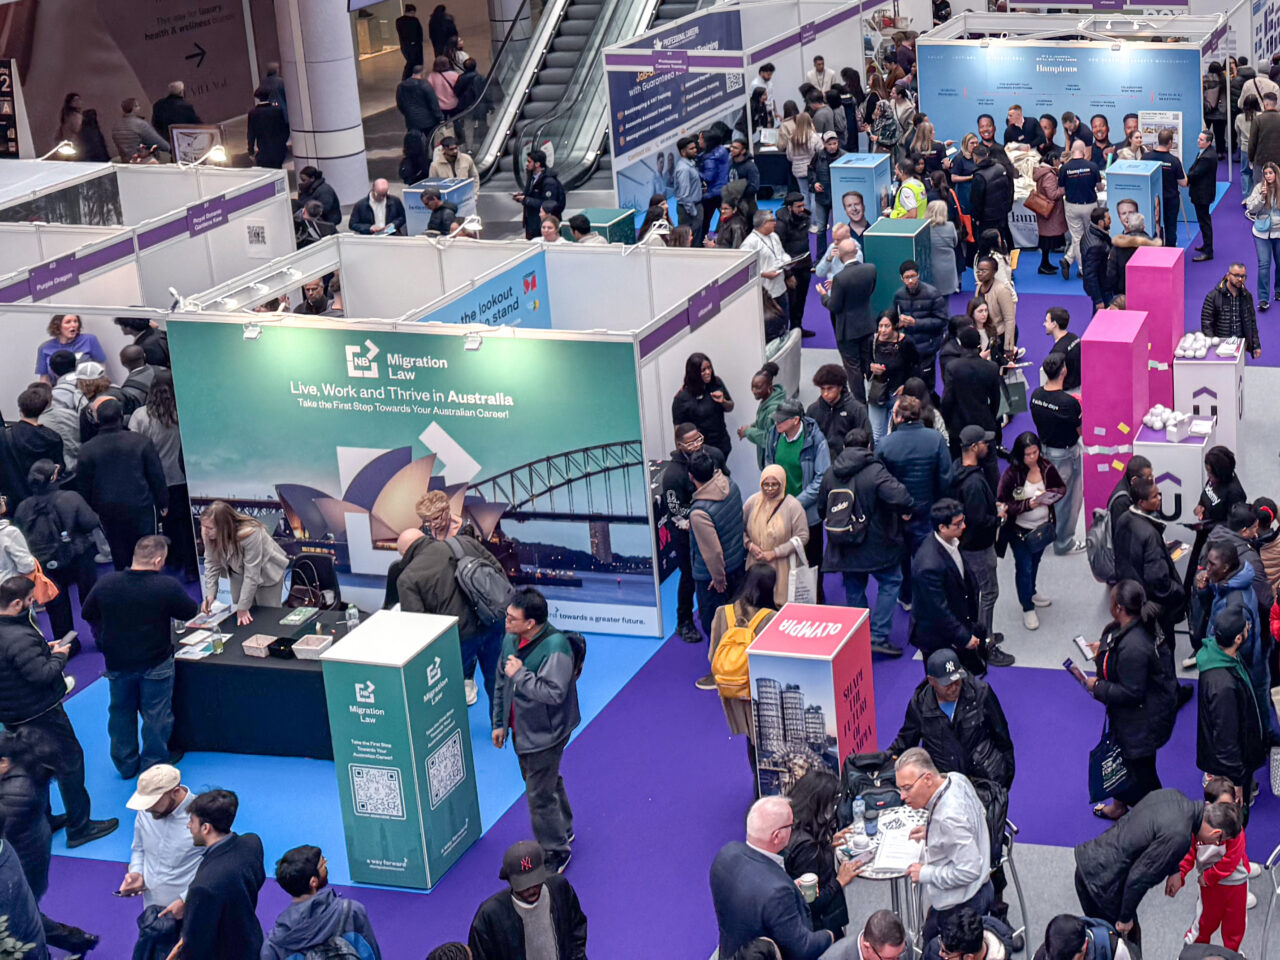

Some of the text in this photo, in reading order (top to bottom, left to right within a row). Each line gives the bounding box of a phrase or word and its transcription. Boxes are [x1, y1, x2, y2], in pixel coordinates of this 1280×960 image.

[629, 74, 675, 96] with Guaranteed
[37, 273, 72, 290] Purple Dragon
[479, 286, 513, 316] lookout
[492, 297, 519, 323] stand
[354, 357, 369, 367] NB
[387, 353, 448, 368] Migration
[388, 368, 416, 380] Law
[290, 381, 514, 406] Live, Work and Thrive in Australia
[297, 398, 509, 419] Take the First Step Towards Your Australian Career!
[560, 612, 587, 620] towards
[778, 618, 843, 638] OLYMPIA
[349, 705, 384, 715] Migration
